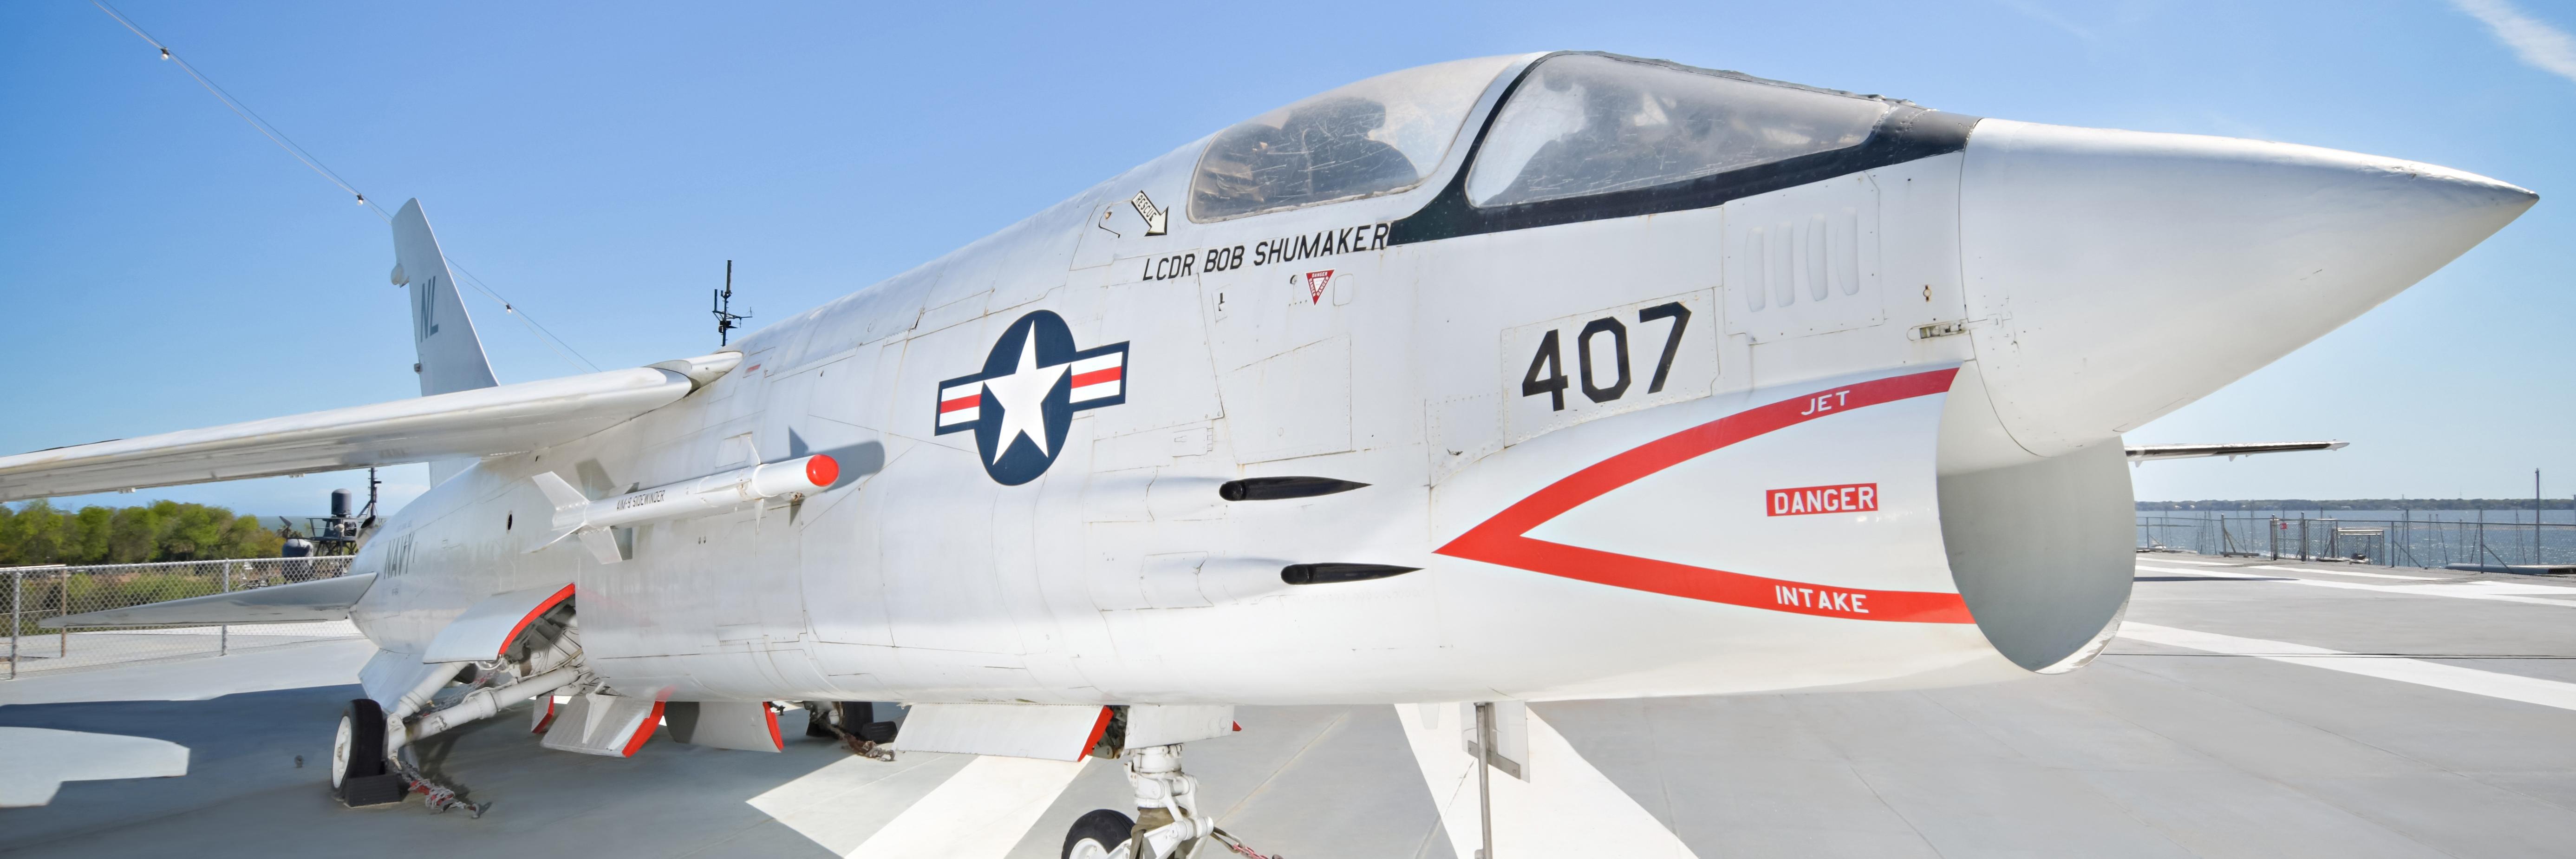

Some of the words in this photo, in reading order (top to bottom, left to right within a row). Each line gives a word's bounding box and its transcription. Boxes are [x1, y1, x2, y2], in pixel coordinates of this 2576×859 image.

[1135, 195, 1157, 222] RESCUE
[1142, 253, 1196, 281] LCDR
[1204, 245, 1245, 273] BOB
[1253, 223, 1391, 267] SHUMAKER
[1317, 276, 1329, 296] DANGER
[420, 275, 439, 343] NL
[1522, 301, 1692, 412] 407
[1801, 390, 1850, 416] JET
[617, 497, 632, 511] AIM-9
[633, 490, 665, 507] SIDEWINDER
[1774, 486, 1874, 514] DANGER
[384, 531, 416, 579] NAVY
[1775, 585, 1869, 614] INTAKE
